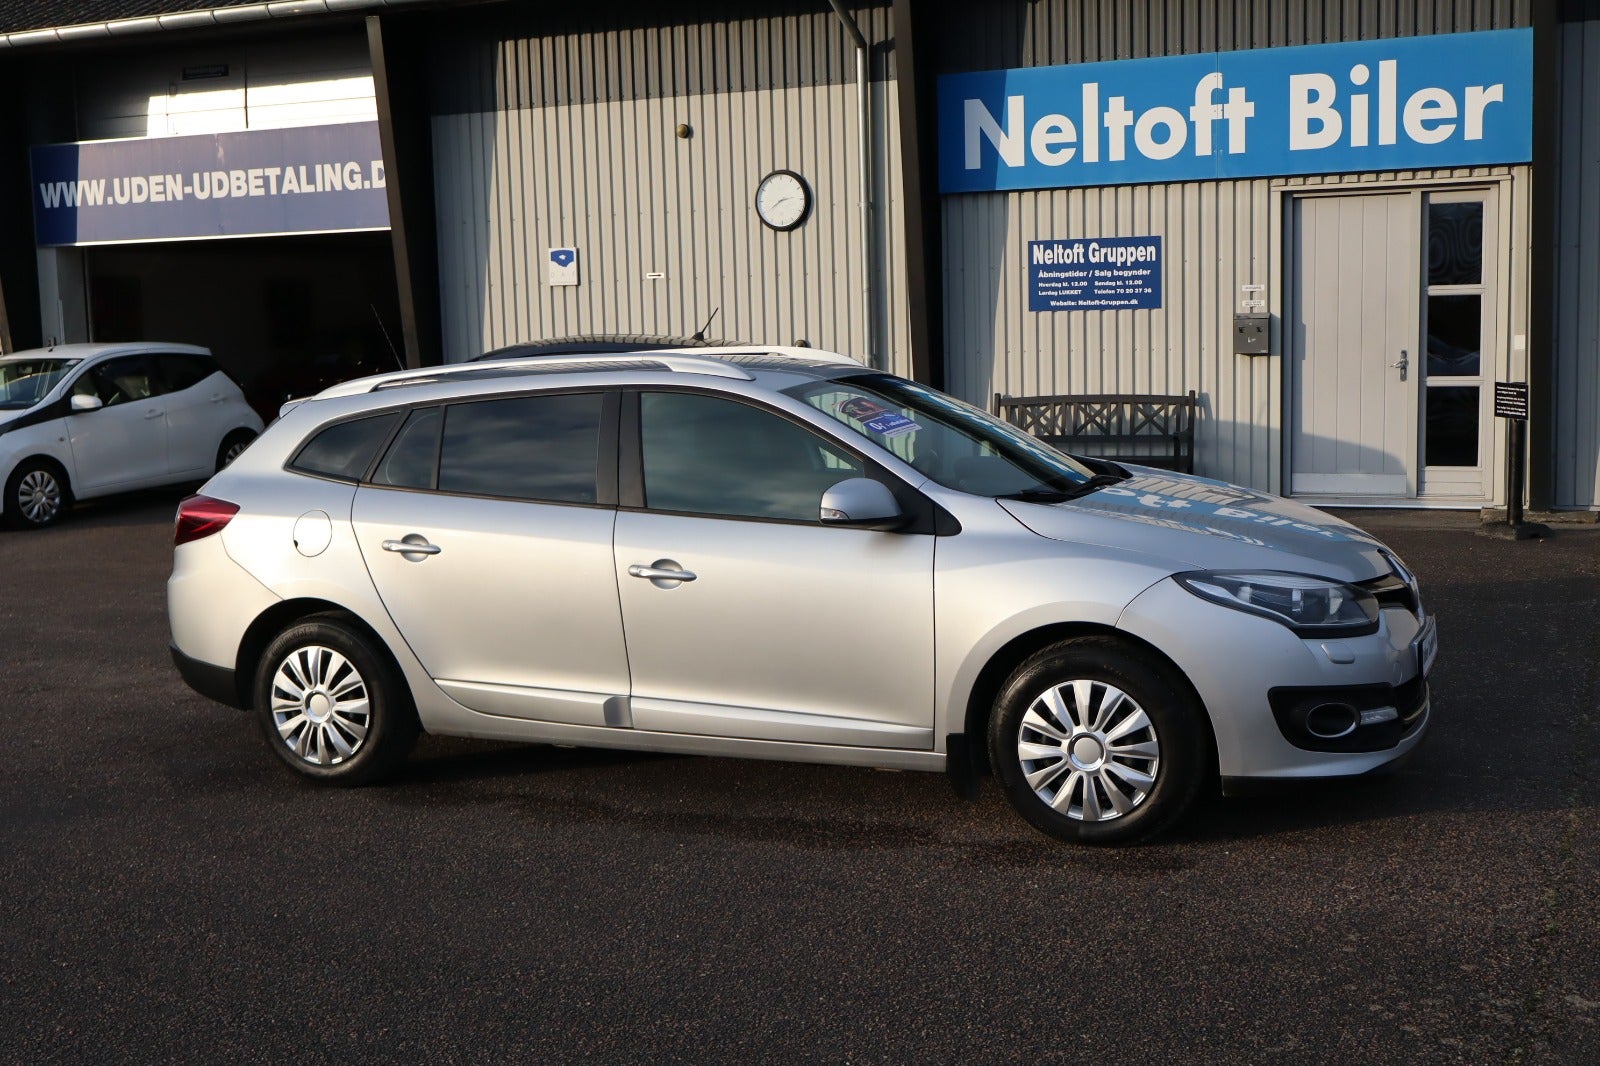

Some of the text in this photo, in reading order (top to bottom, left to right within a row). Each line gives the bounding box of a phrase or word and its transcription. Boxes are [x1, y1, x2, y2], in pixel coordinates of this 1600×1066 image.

[964, 59, 1504, 170] Neltoft Biler
[1033, 242, 1156, 266] Neltoft Gruppen
[1038, 270, 1087, 278] Åbningstider
[1094, 269, 1112, 277] Salg
[1113, 268, 1151, 277] begynder
